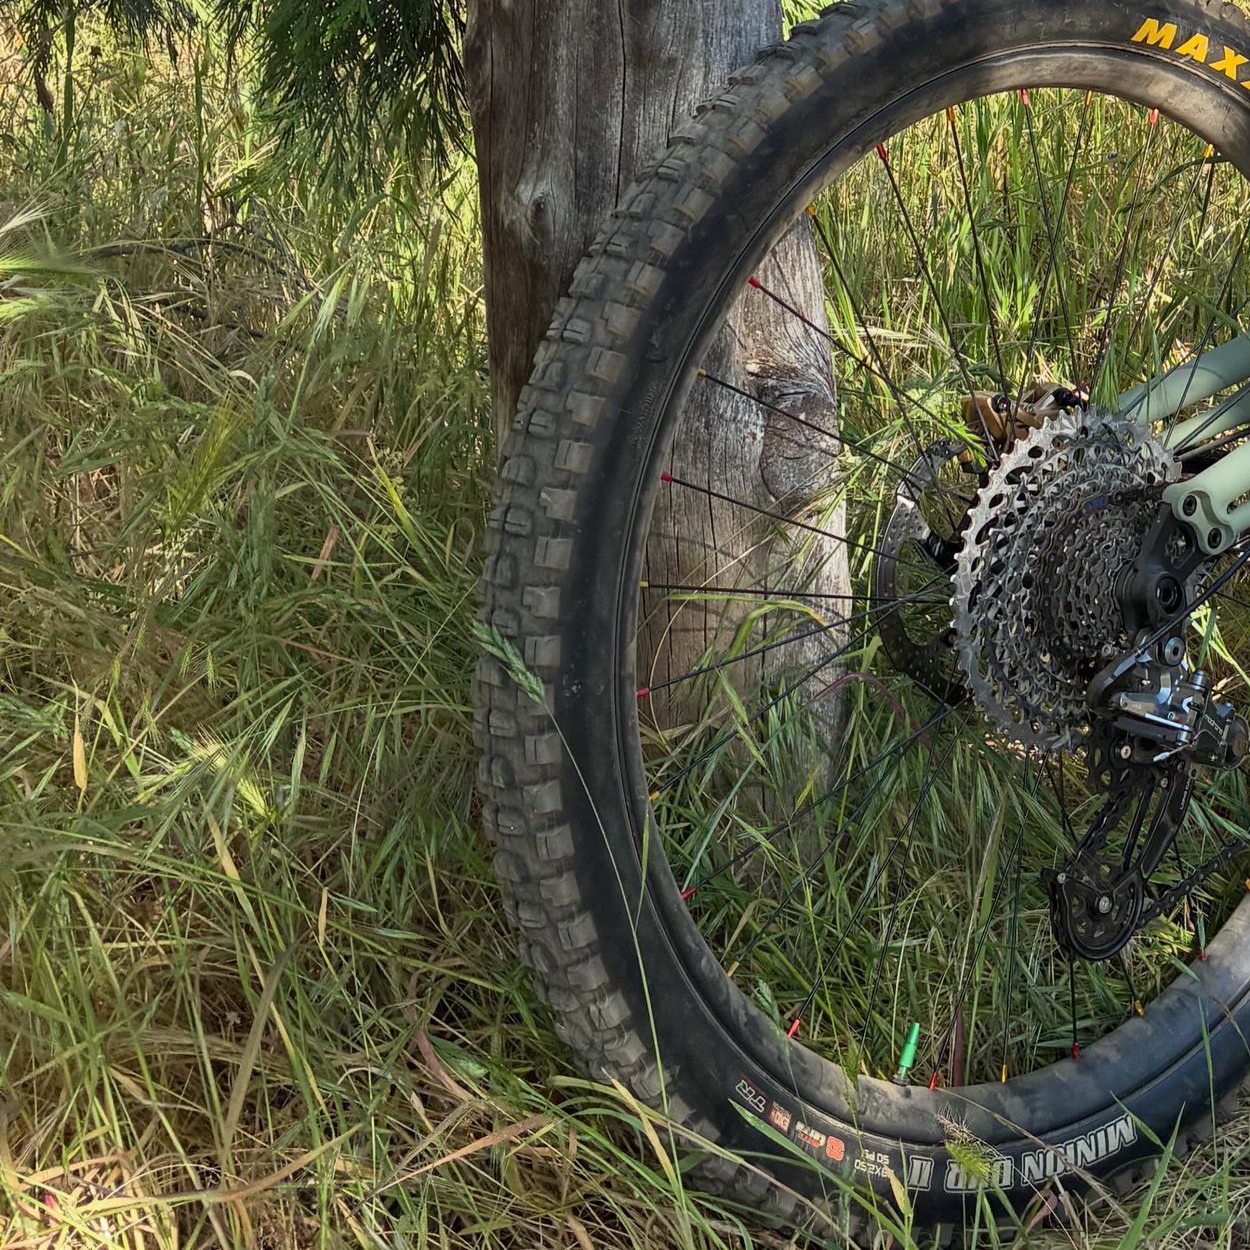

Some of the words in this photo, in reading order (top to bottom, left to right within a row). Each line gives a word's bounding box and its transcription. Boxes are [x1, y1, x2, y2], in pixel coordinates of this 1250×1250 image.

[735, 1079, 766, 1113] TR
[877, 1153, 890, 1165] 50
[1021, 1112, 1138, 1188] MINION
[908, 1155, 935, 1192] II
